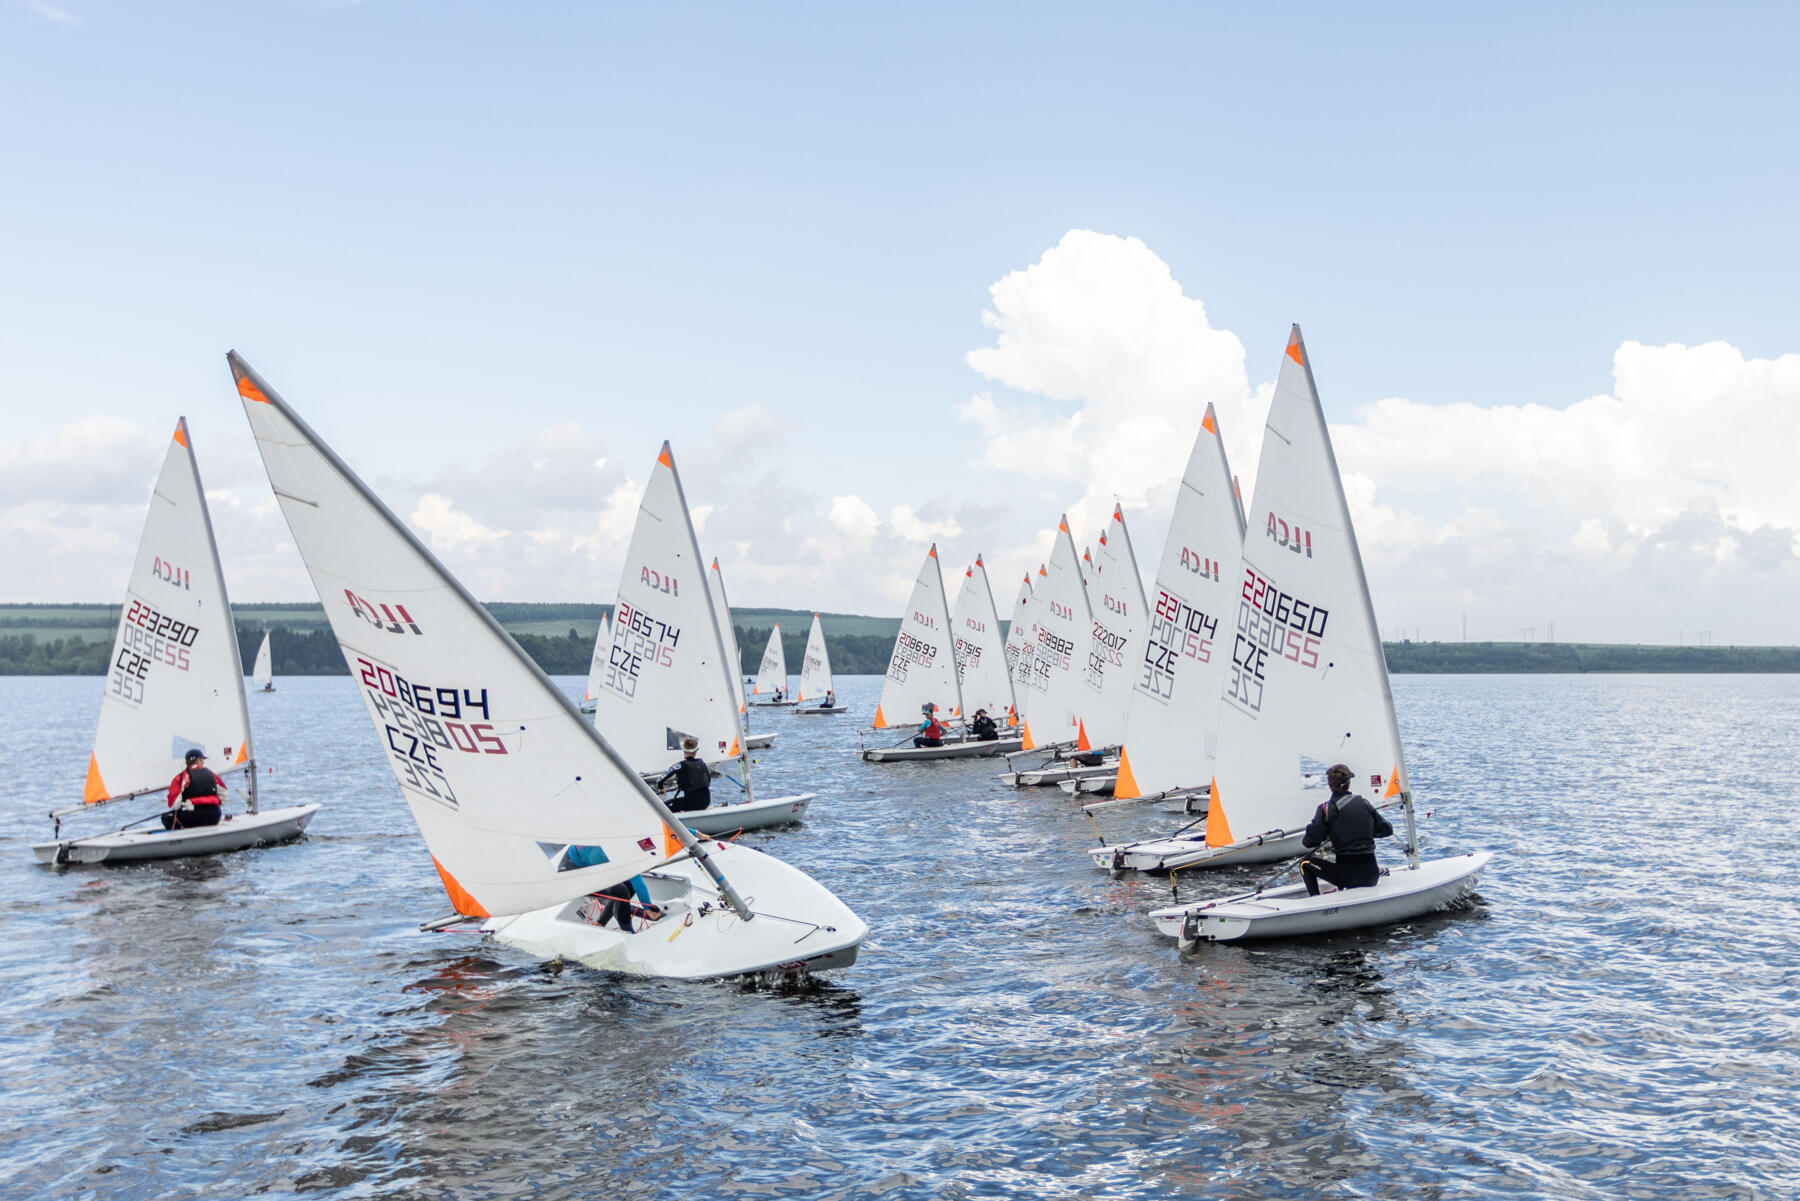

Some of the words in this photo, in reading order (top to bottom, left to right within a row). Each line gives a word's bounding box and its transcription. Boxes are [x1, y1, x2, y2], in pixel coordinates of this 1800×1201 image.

[1156, 591, 1218, 640] 221704
[1242, 568, 1329, 638] 220650
[127, 600, 199, 647] 223290
[618, 602, 680, 647] 216574
[1093, 621, 1127, 651] 222017
[899, 632, 937, 658] 208693
[1038, 627, 1074, 656] 218982
[1145, 640, 1178, 675] CZE
[1232, 633, 1269, 680] CZE
[610, 644, 642, 677] CZE
[892, 655, 911, 672] CZE
[1034, 657, 1051, 678] CZE
[1089, 652, 1105, 675] CZE
[357, 657, 490, 720] 208694
[385, 724, 443, 773] CZE
